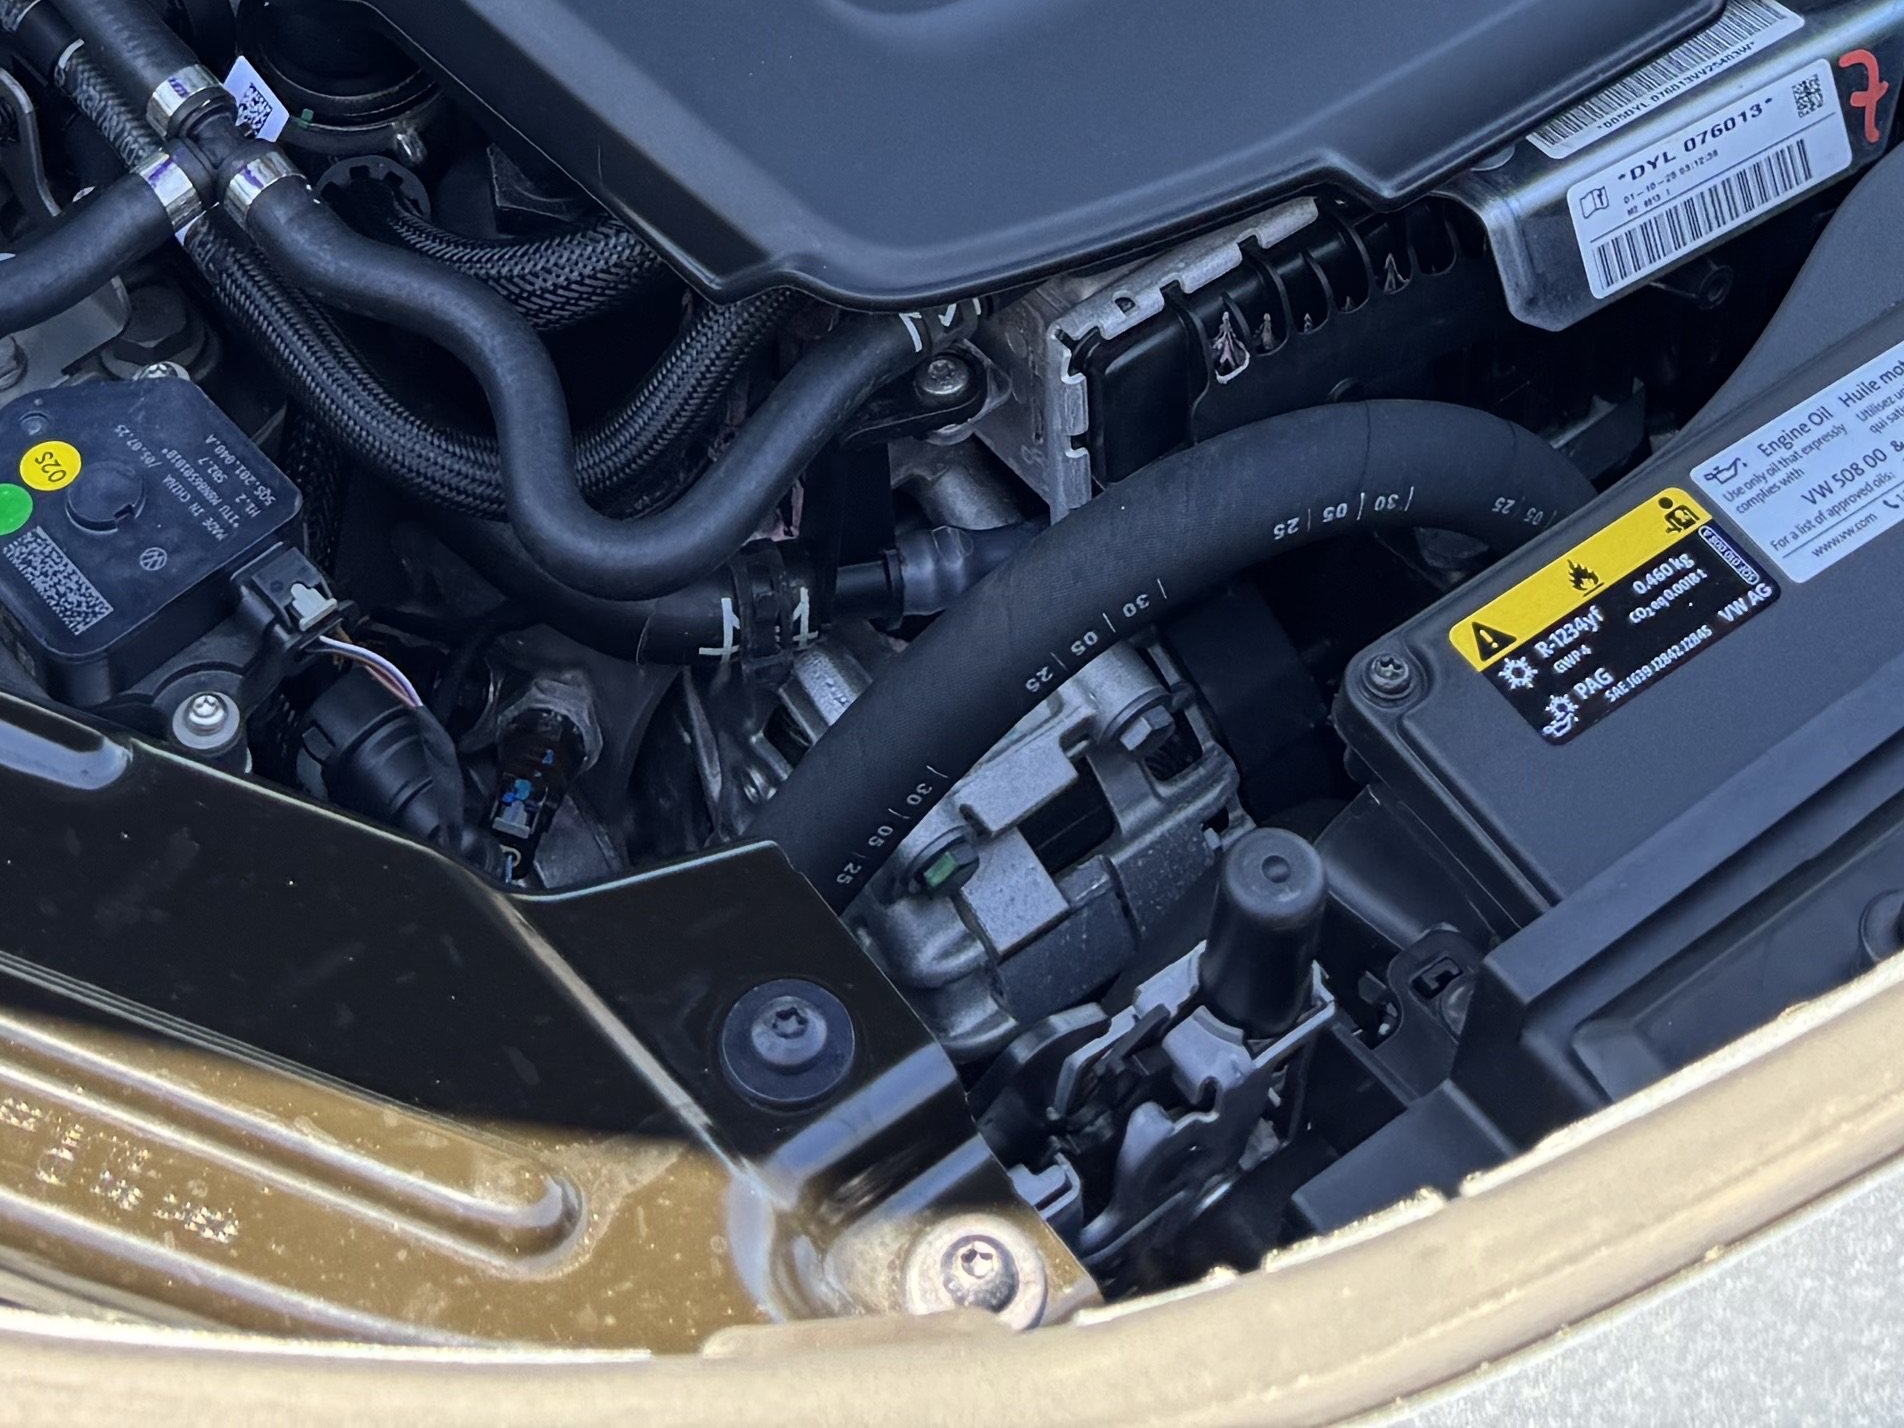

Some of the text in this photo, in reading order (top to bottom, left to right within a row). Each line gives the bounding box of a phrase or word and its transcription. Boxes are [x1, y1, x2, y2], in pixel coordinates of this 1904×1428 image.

[1838, 49, 1889, 143] 7
[1837, 377, 1881, 408] Huile
[1855, 394, 1895, 422] Utilisez
[1756, 405, 1834, 461] Engine Oil
[1867, 417, 1891, 436] qui
[1722, 422, 1851, 503] Use only oil that expressly
[1800, 480, 1836, 506] VW
[1830, 460, 1868, 488] 508
[1860, 447, 1889, 469] 00
[158, 473, 194, 502] CHINA
[186, 502, 206, 516] IN
[1733, 465, 1806, 516] complies with
[1769, 468, 1897, 552] For a list of approved oils:
[200, 516, 229, 540] MADE
[1273, 494, 1399, 540] 30 05 25
[1809, 511, 1879, 558] www.vw.com
[1630, 549, 1696, 595] 0.460 kg
[1716, 580, 1775, 624] VW AG
[1025, 593, 1150, 693] 30 05 25
[1531, 604, 1611, 663] R-1234yf
[1550, 642, 1593, 674] GWP 4
[1602, 623, 1714, 703] SAE J639 J2842 J2845
[1571, 666, 1615, 700] PAG
[835, 782, 933, 885] 30 05 25
